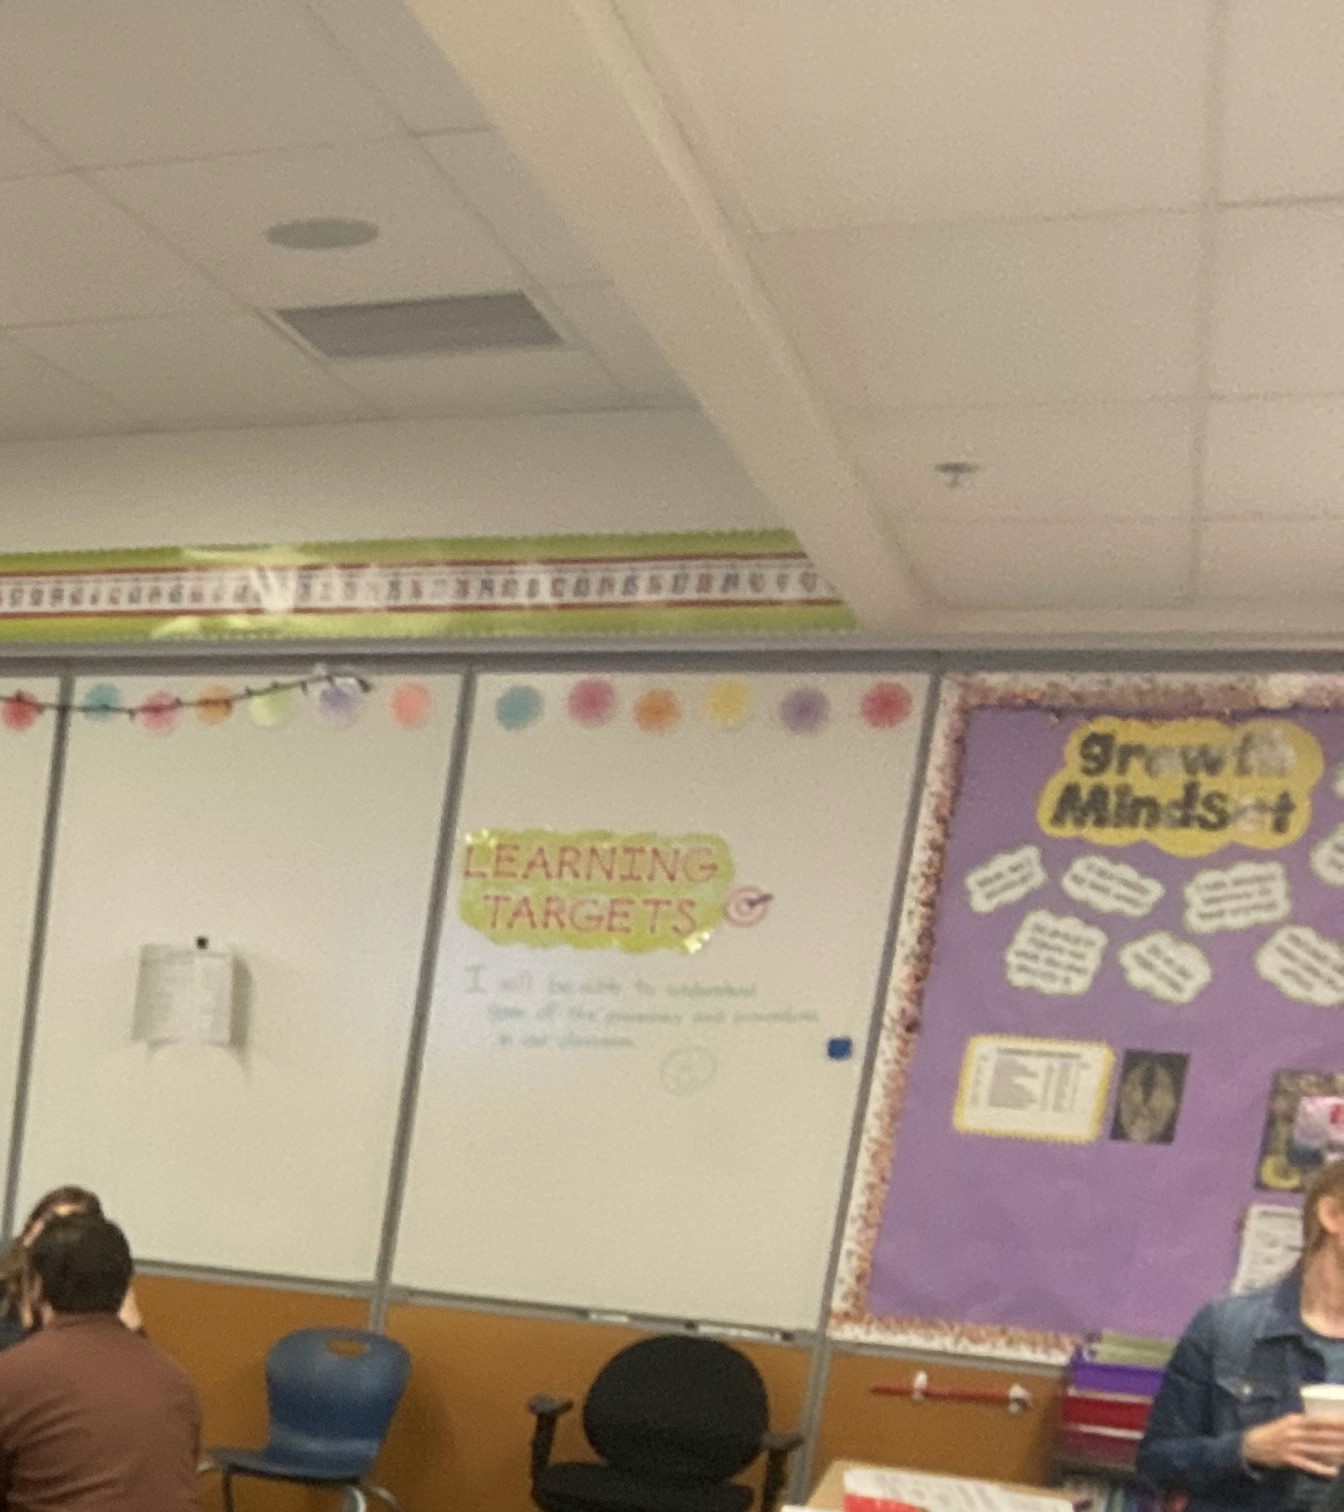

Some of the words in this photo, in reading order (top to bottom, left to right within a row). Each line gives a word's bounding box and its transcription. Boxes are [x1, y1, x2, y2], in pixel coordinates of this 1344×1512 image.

[1080, 730, 1295, 778] growt
[463, 842, 718, 882] LEARNING
[484, 894, 697, 936] TARGETS
[464, 965, 487, 993] I
